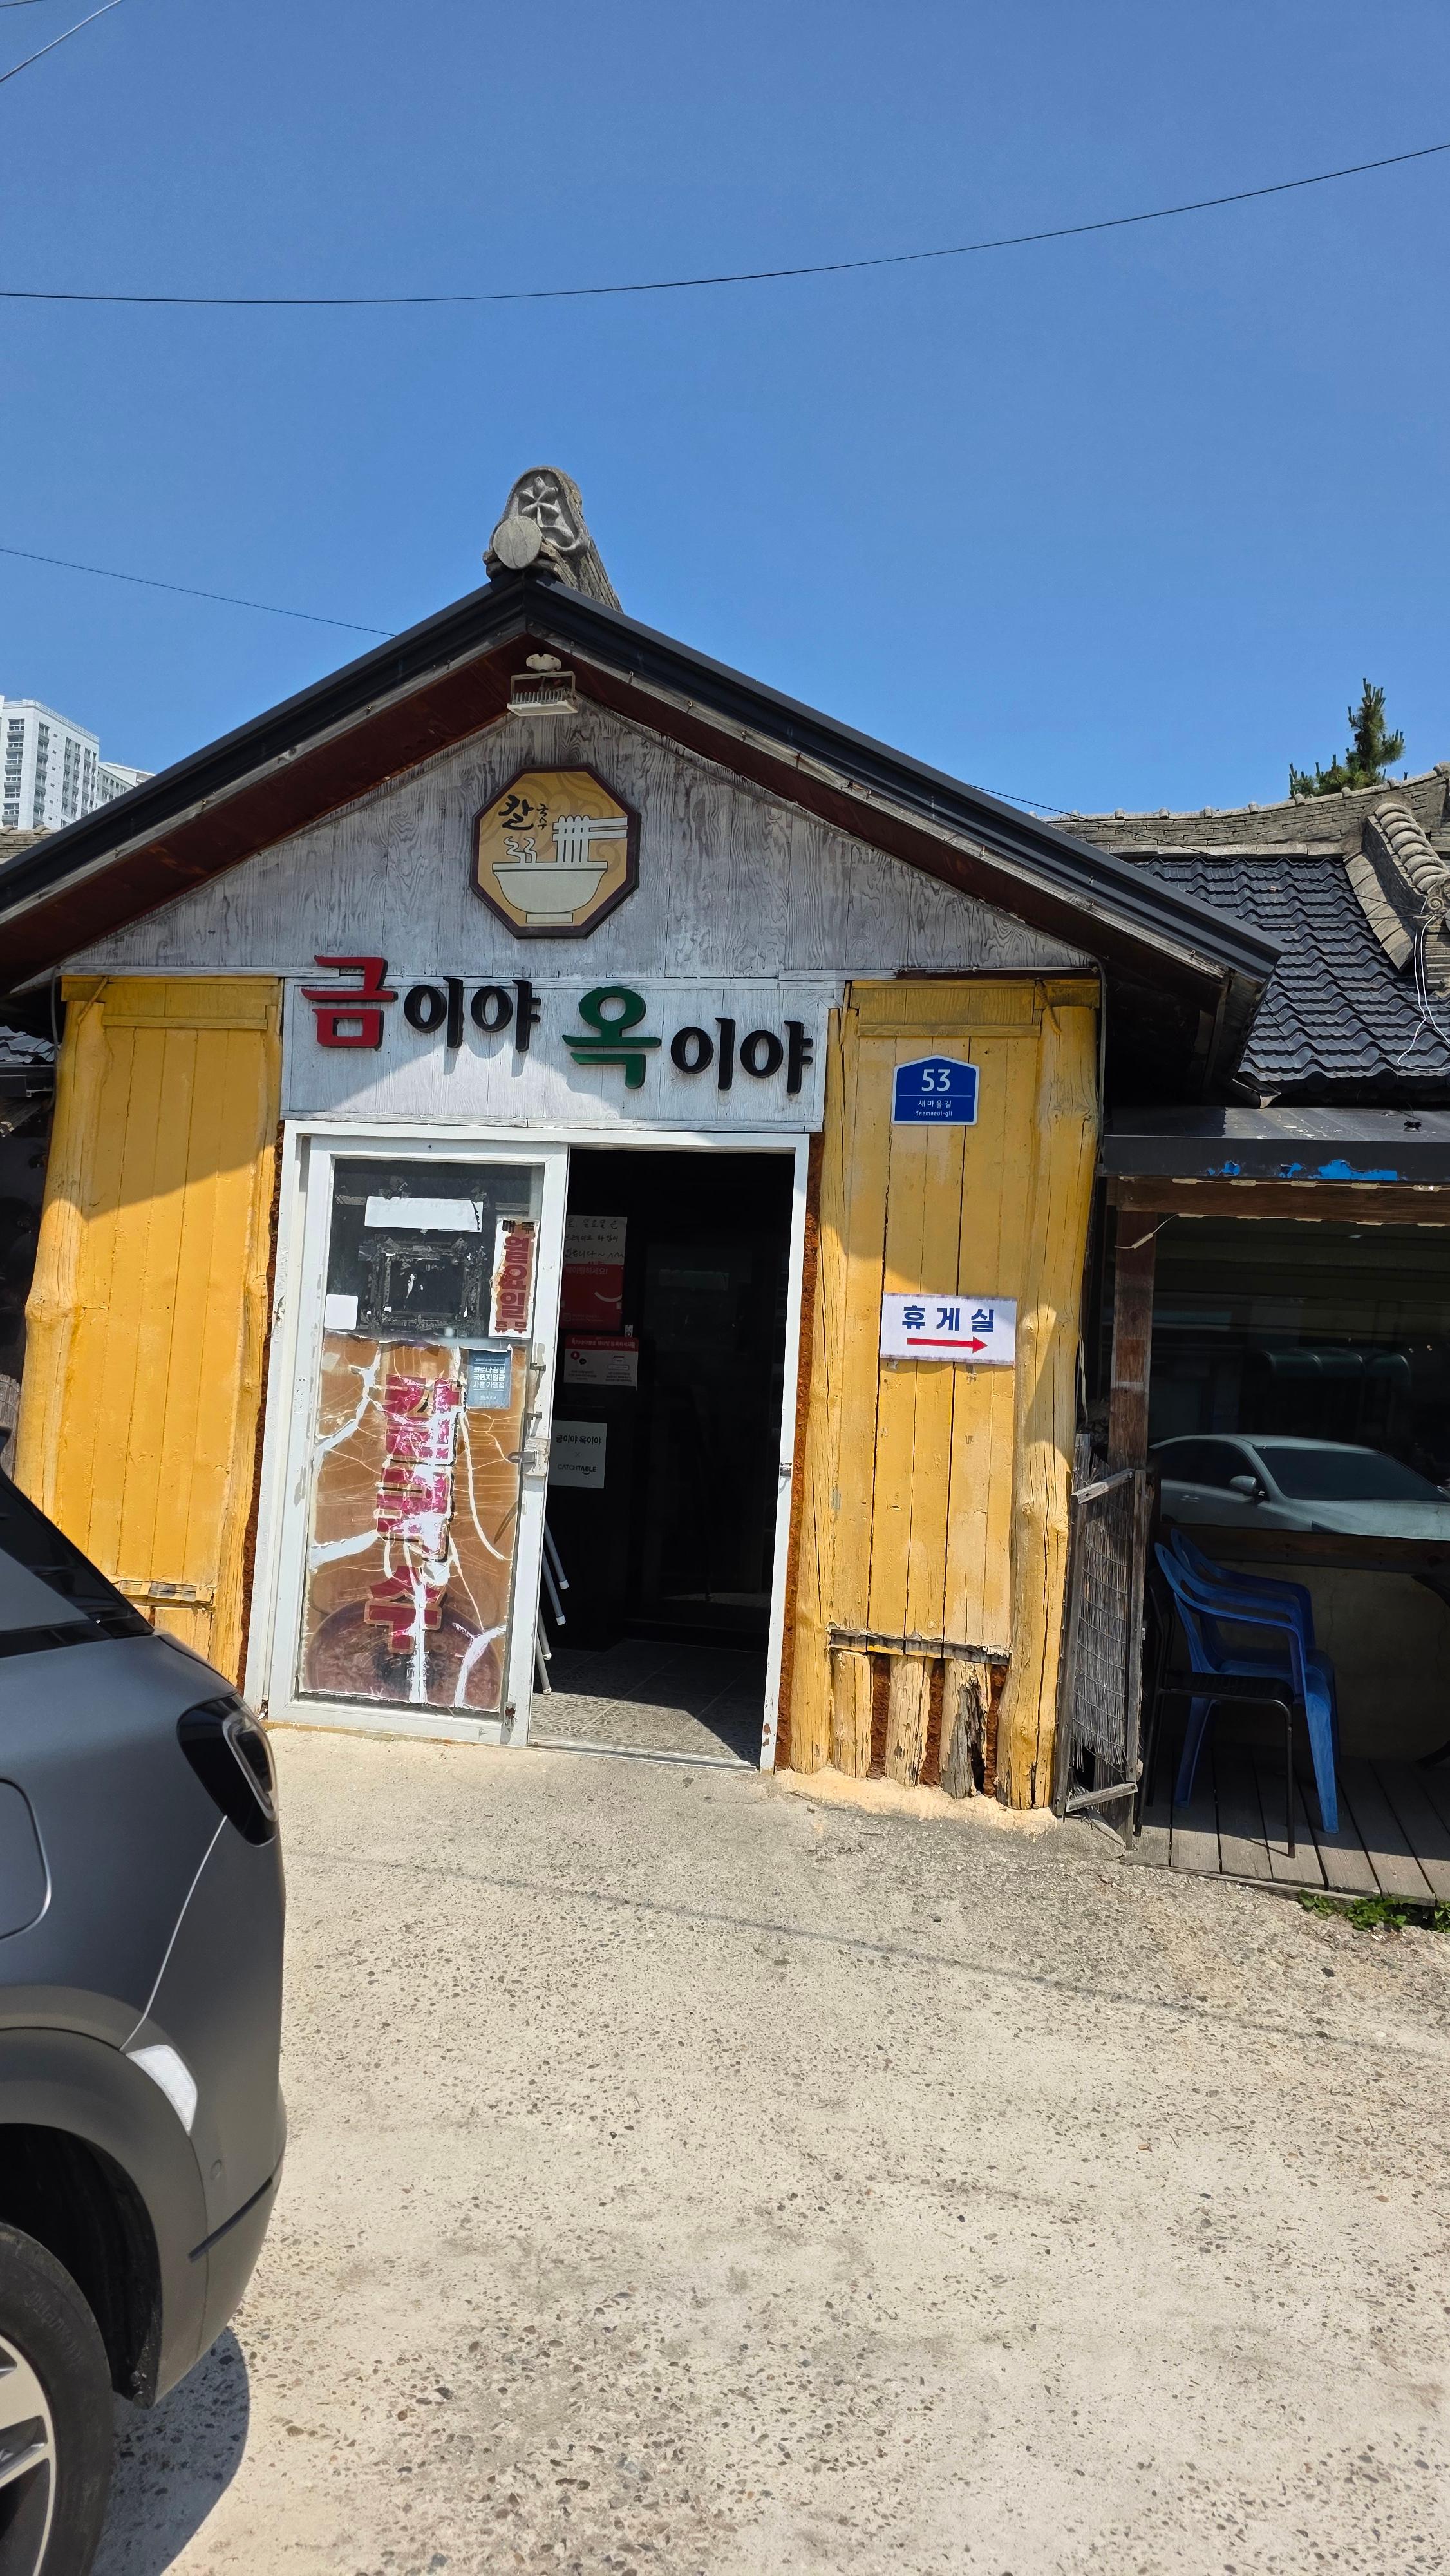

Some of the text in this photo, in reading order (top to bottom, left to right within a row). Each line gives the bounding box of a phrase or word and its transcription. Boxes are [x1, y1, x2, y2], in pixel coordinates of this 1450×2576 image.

[301, 954, 814, 1095] 금이야 옥이야
[921, 1068, 951, 1092] 53
[918, 1099, 952, 1109] 새마을길
[499, 1236, 529, 1320] 월요일
[902, 1305, 995, 1333] 휴게실
[556, 1434, 601, 1446] 금이야 옥이야
